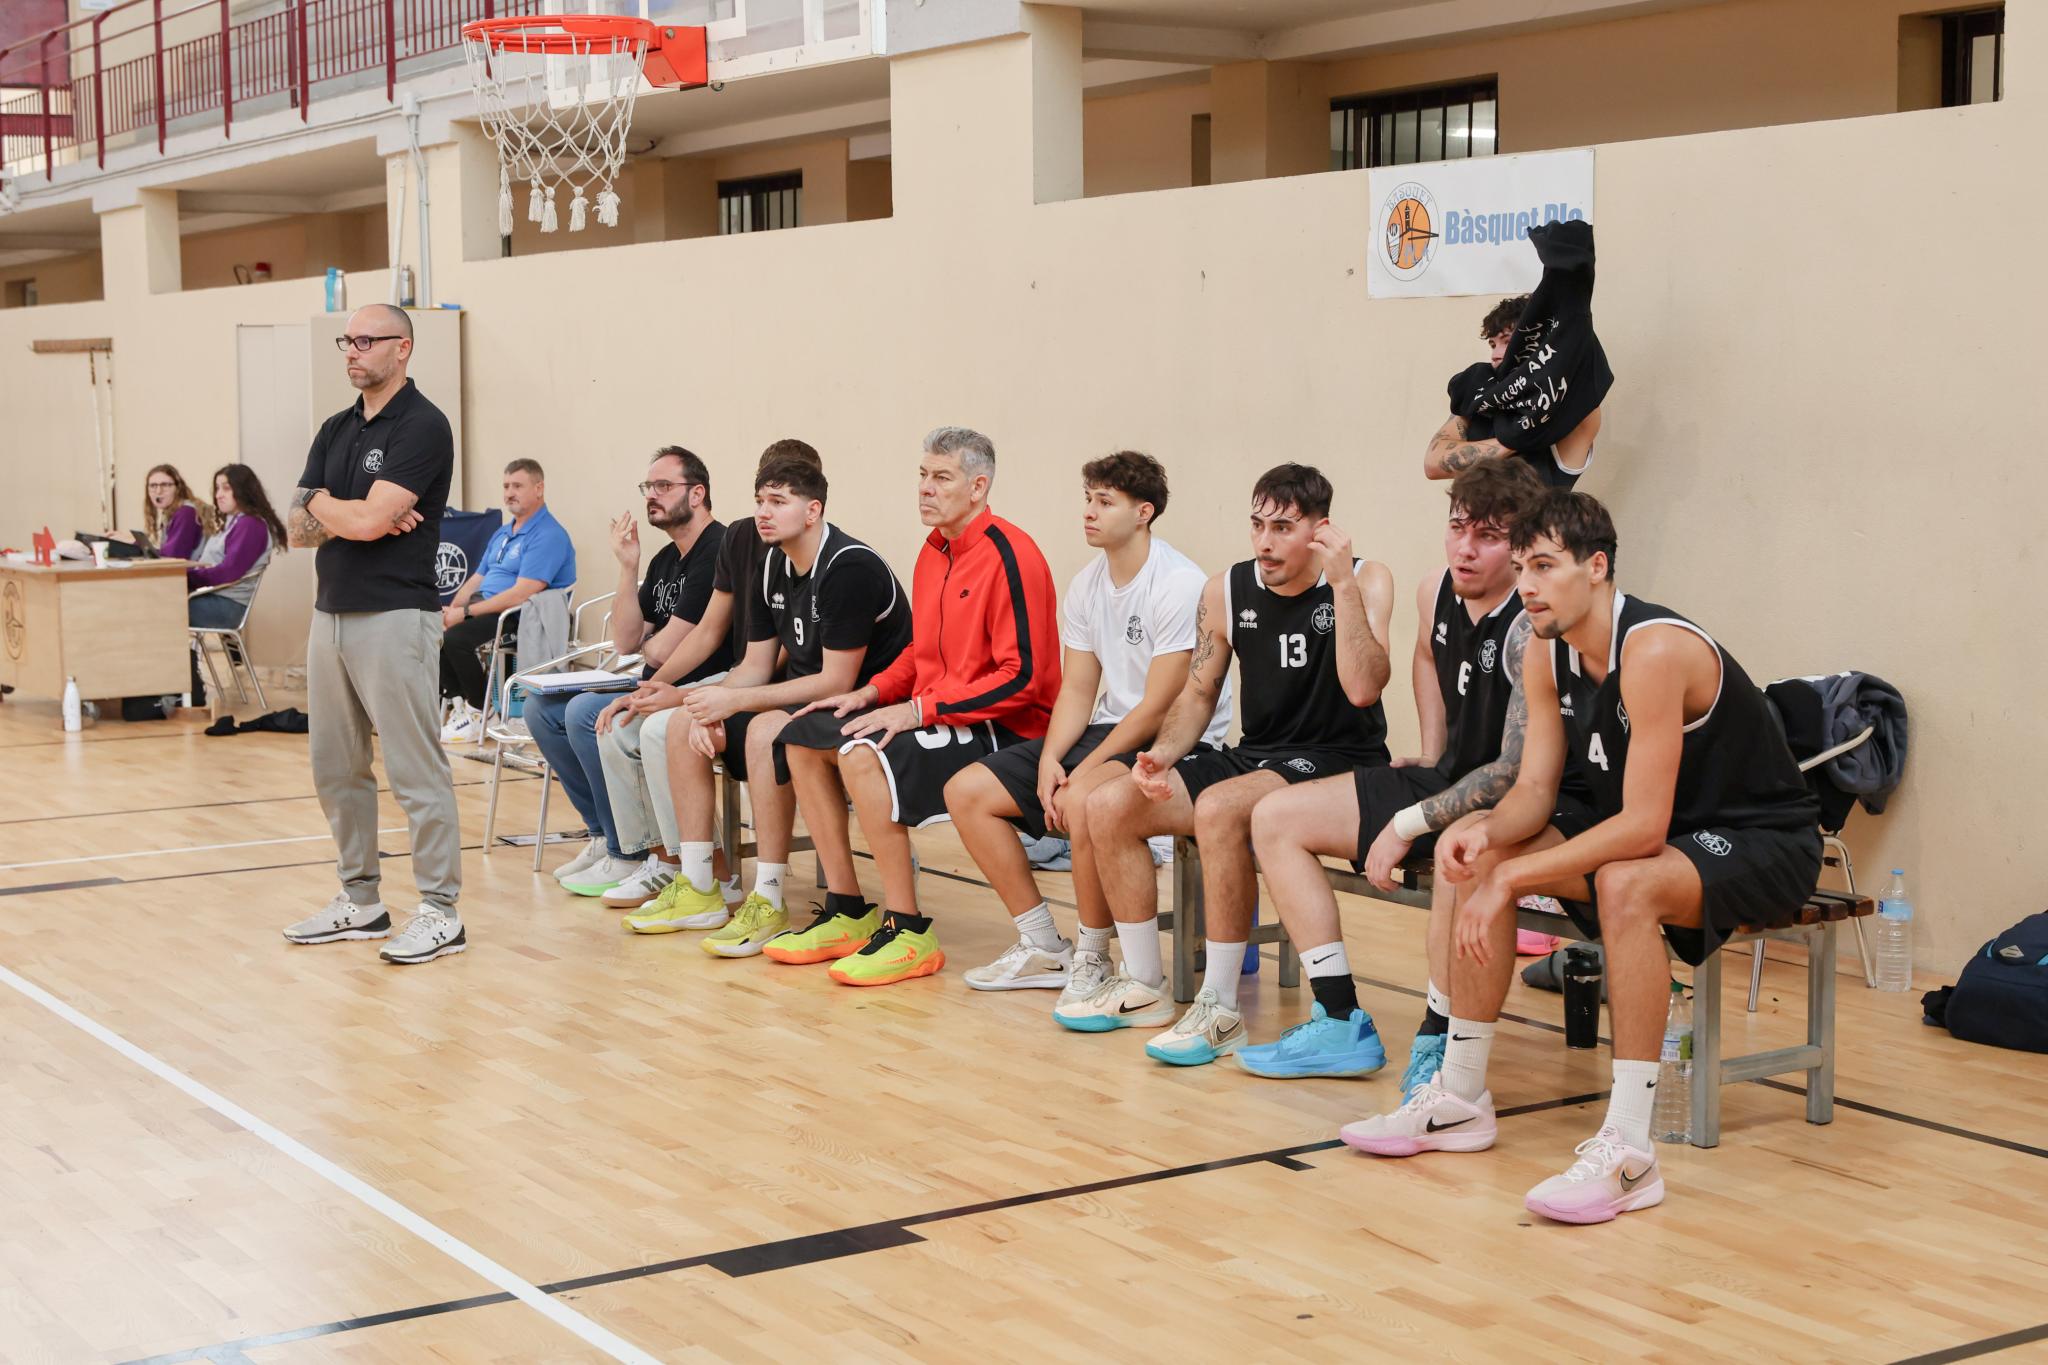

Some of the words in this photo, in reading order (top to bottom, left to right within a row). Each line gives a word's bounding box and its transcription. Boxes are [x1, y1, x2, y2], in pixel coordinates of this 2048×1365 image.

[1445, 207, 1539, 246] Bàsquet
[441, 573, 460, 587] PLA
[793, 617, 804, 646] 9
[1278, 633, 1308, 668] 13
[1587, 732, 1609, 771] 4
